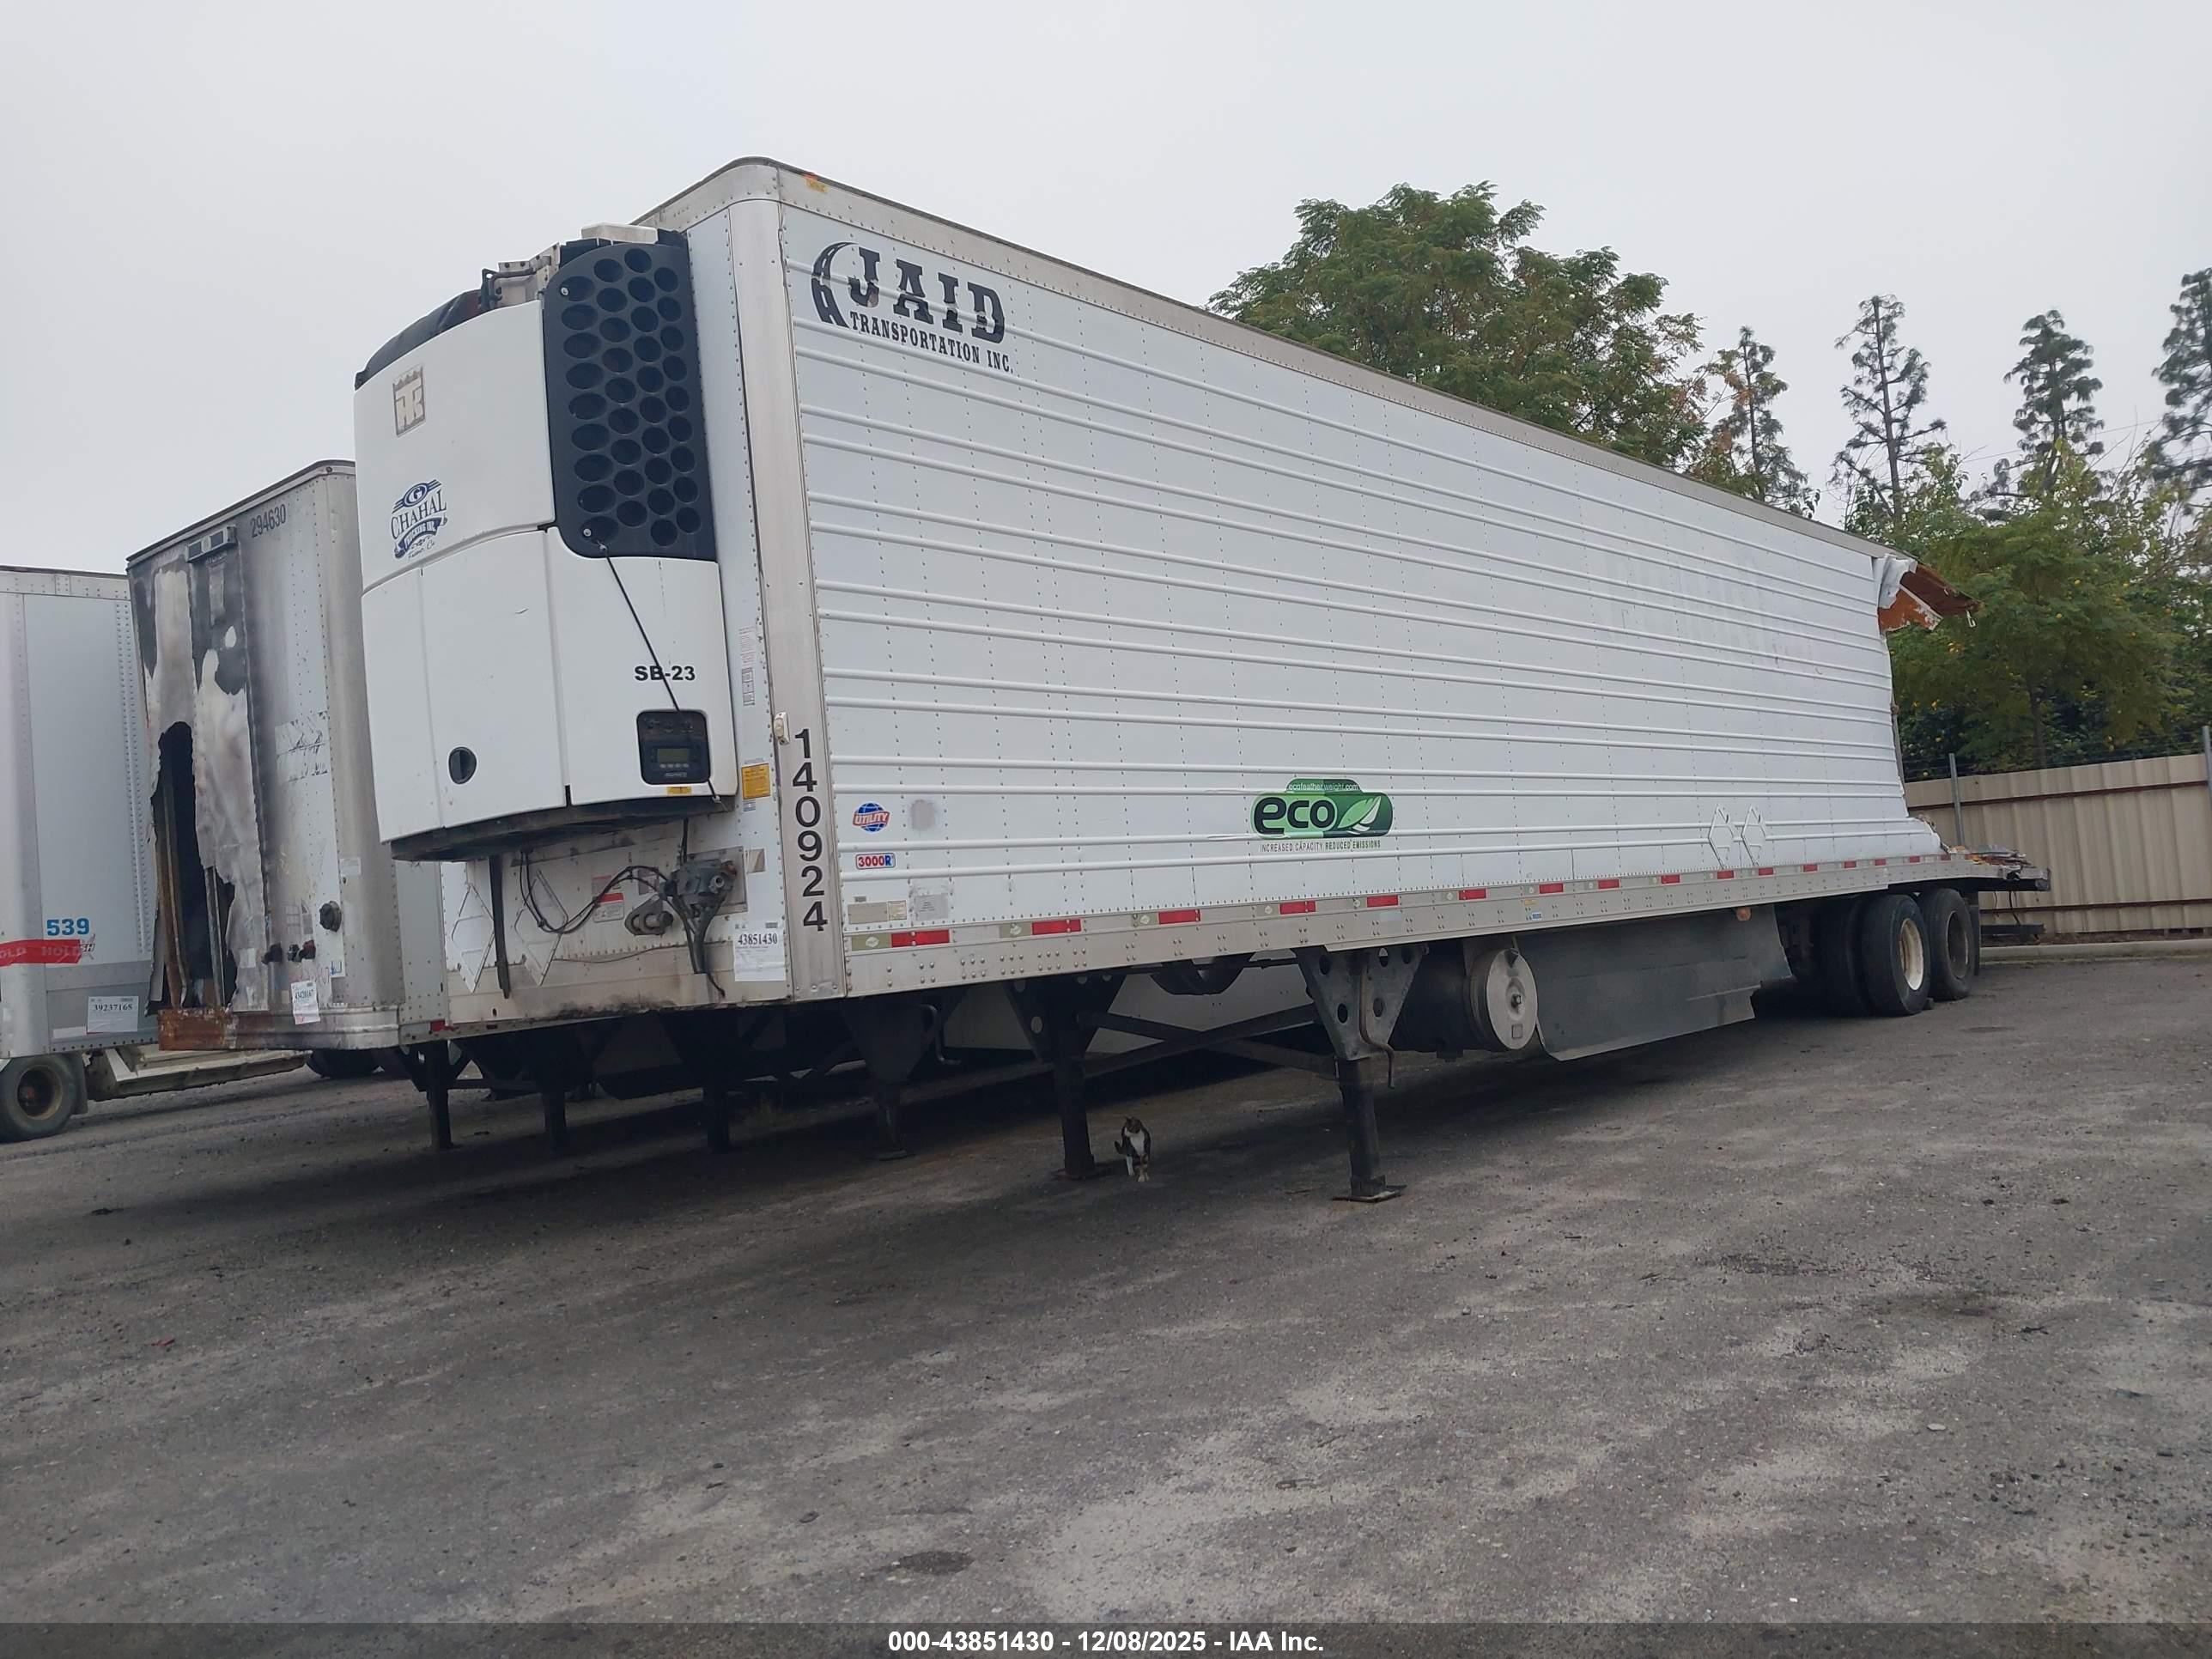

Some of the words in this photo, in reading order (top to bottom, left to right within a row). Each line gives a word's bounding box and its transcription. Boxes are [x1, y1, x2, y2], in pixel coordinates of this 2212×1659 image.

[848, 246, 1006, 344] JAID
[850, 311, 981, 364] TRANSPORTATION
[988, 349, 1013, 374] INC.
[250, 503, 286, 538] 294630
[391, 488, 447, 540] CHAHAL
[634, 665, 696, 682] SB-23
[854, 812, 888, 825] UTILITY
[1254, 796, 1336, 835] eco
[792, 728, 829, 933] 140924
[1260, 842, 1293, 854] INCREASED
[1295, 842, 1323, 852] CAPACITY
[1325, 841, 1352, 851] REDUCED
[1352, 839, 1381, 850] EMISSIONS
[858, 854, 892, 867] 3000R
[46, 917, 90, 936] 539
[738, 933, 778, 945] 43851430
